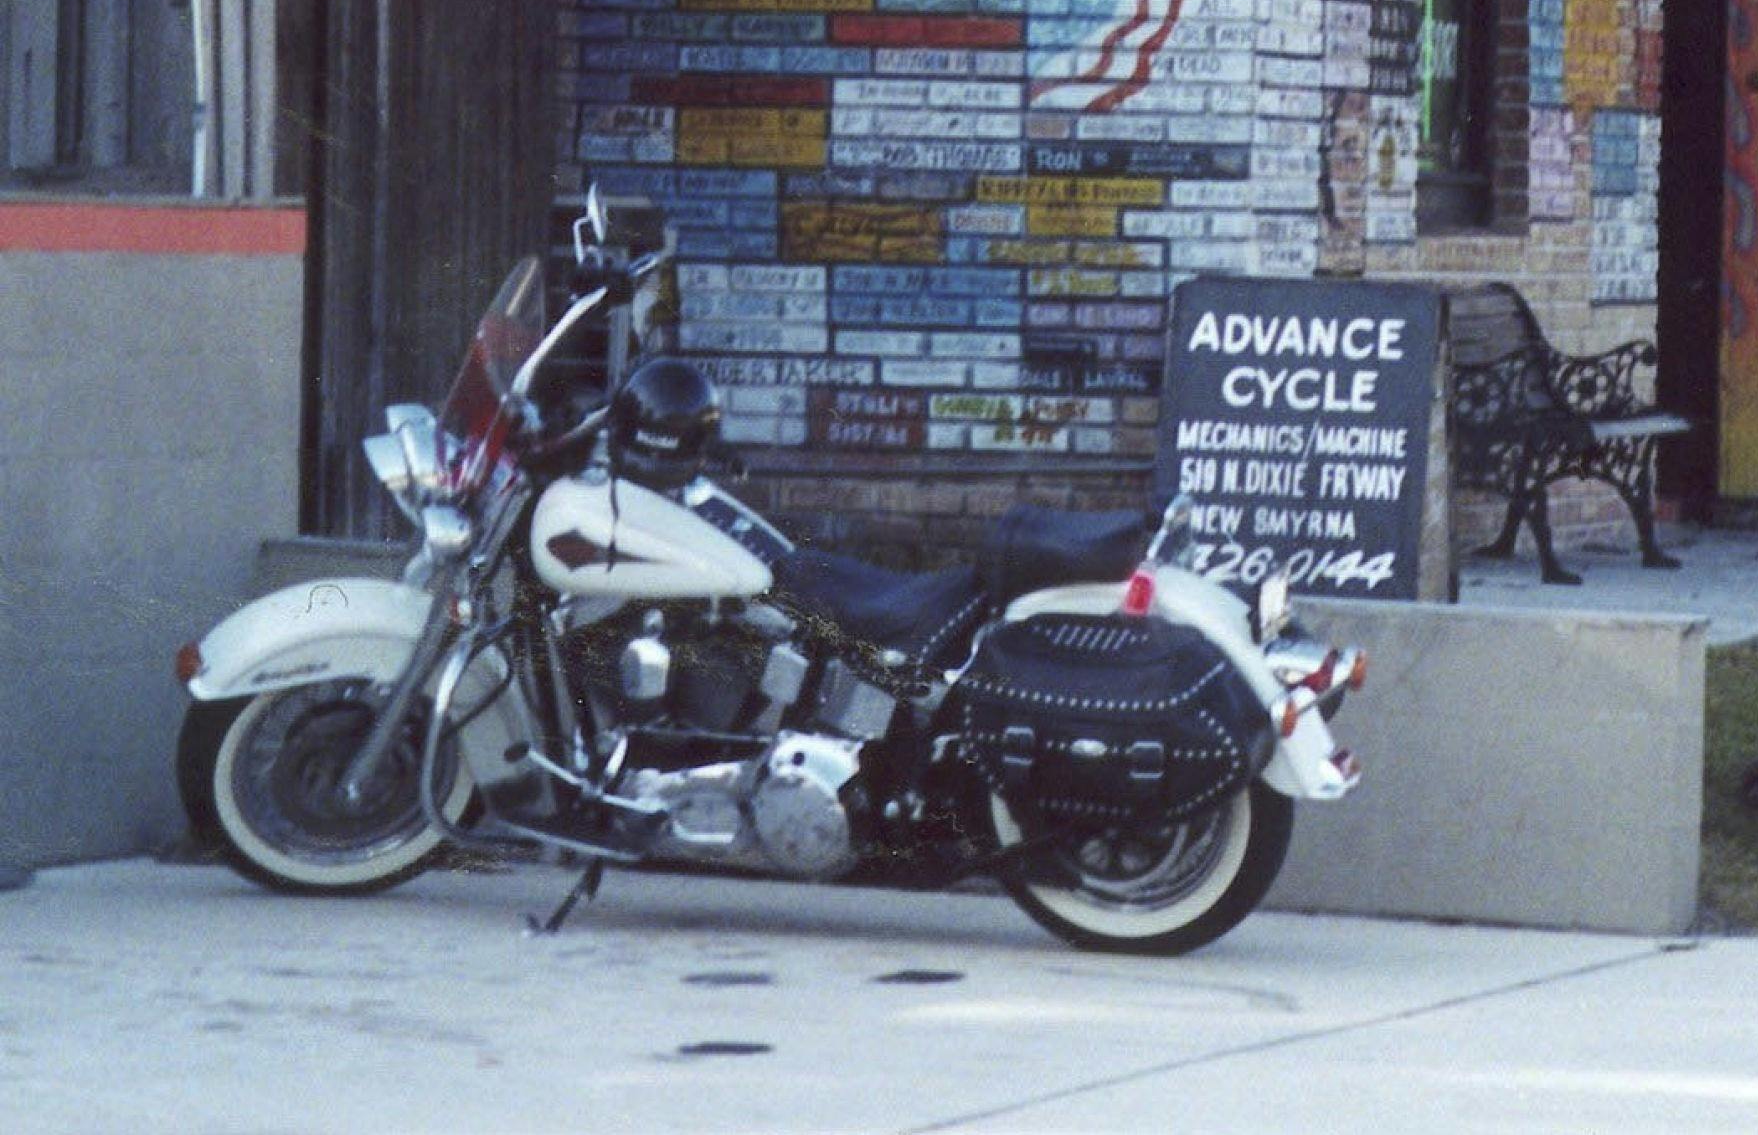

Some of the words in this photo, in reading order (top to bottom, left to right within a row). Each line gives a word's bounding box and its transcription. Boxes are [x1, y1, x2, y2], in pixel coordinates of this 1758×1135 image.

[1187, 310, 1407, 361] ADVANCE
[1221, 365, 1379, 412] CYCLE
[1189, 504, 1244, 535] NEW
[1253, 506, 1357, 541] SMYRNA
